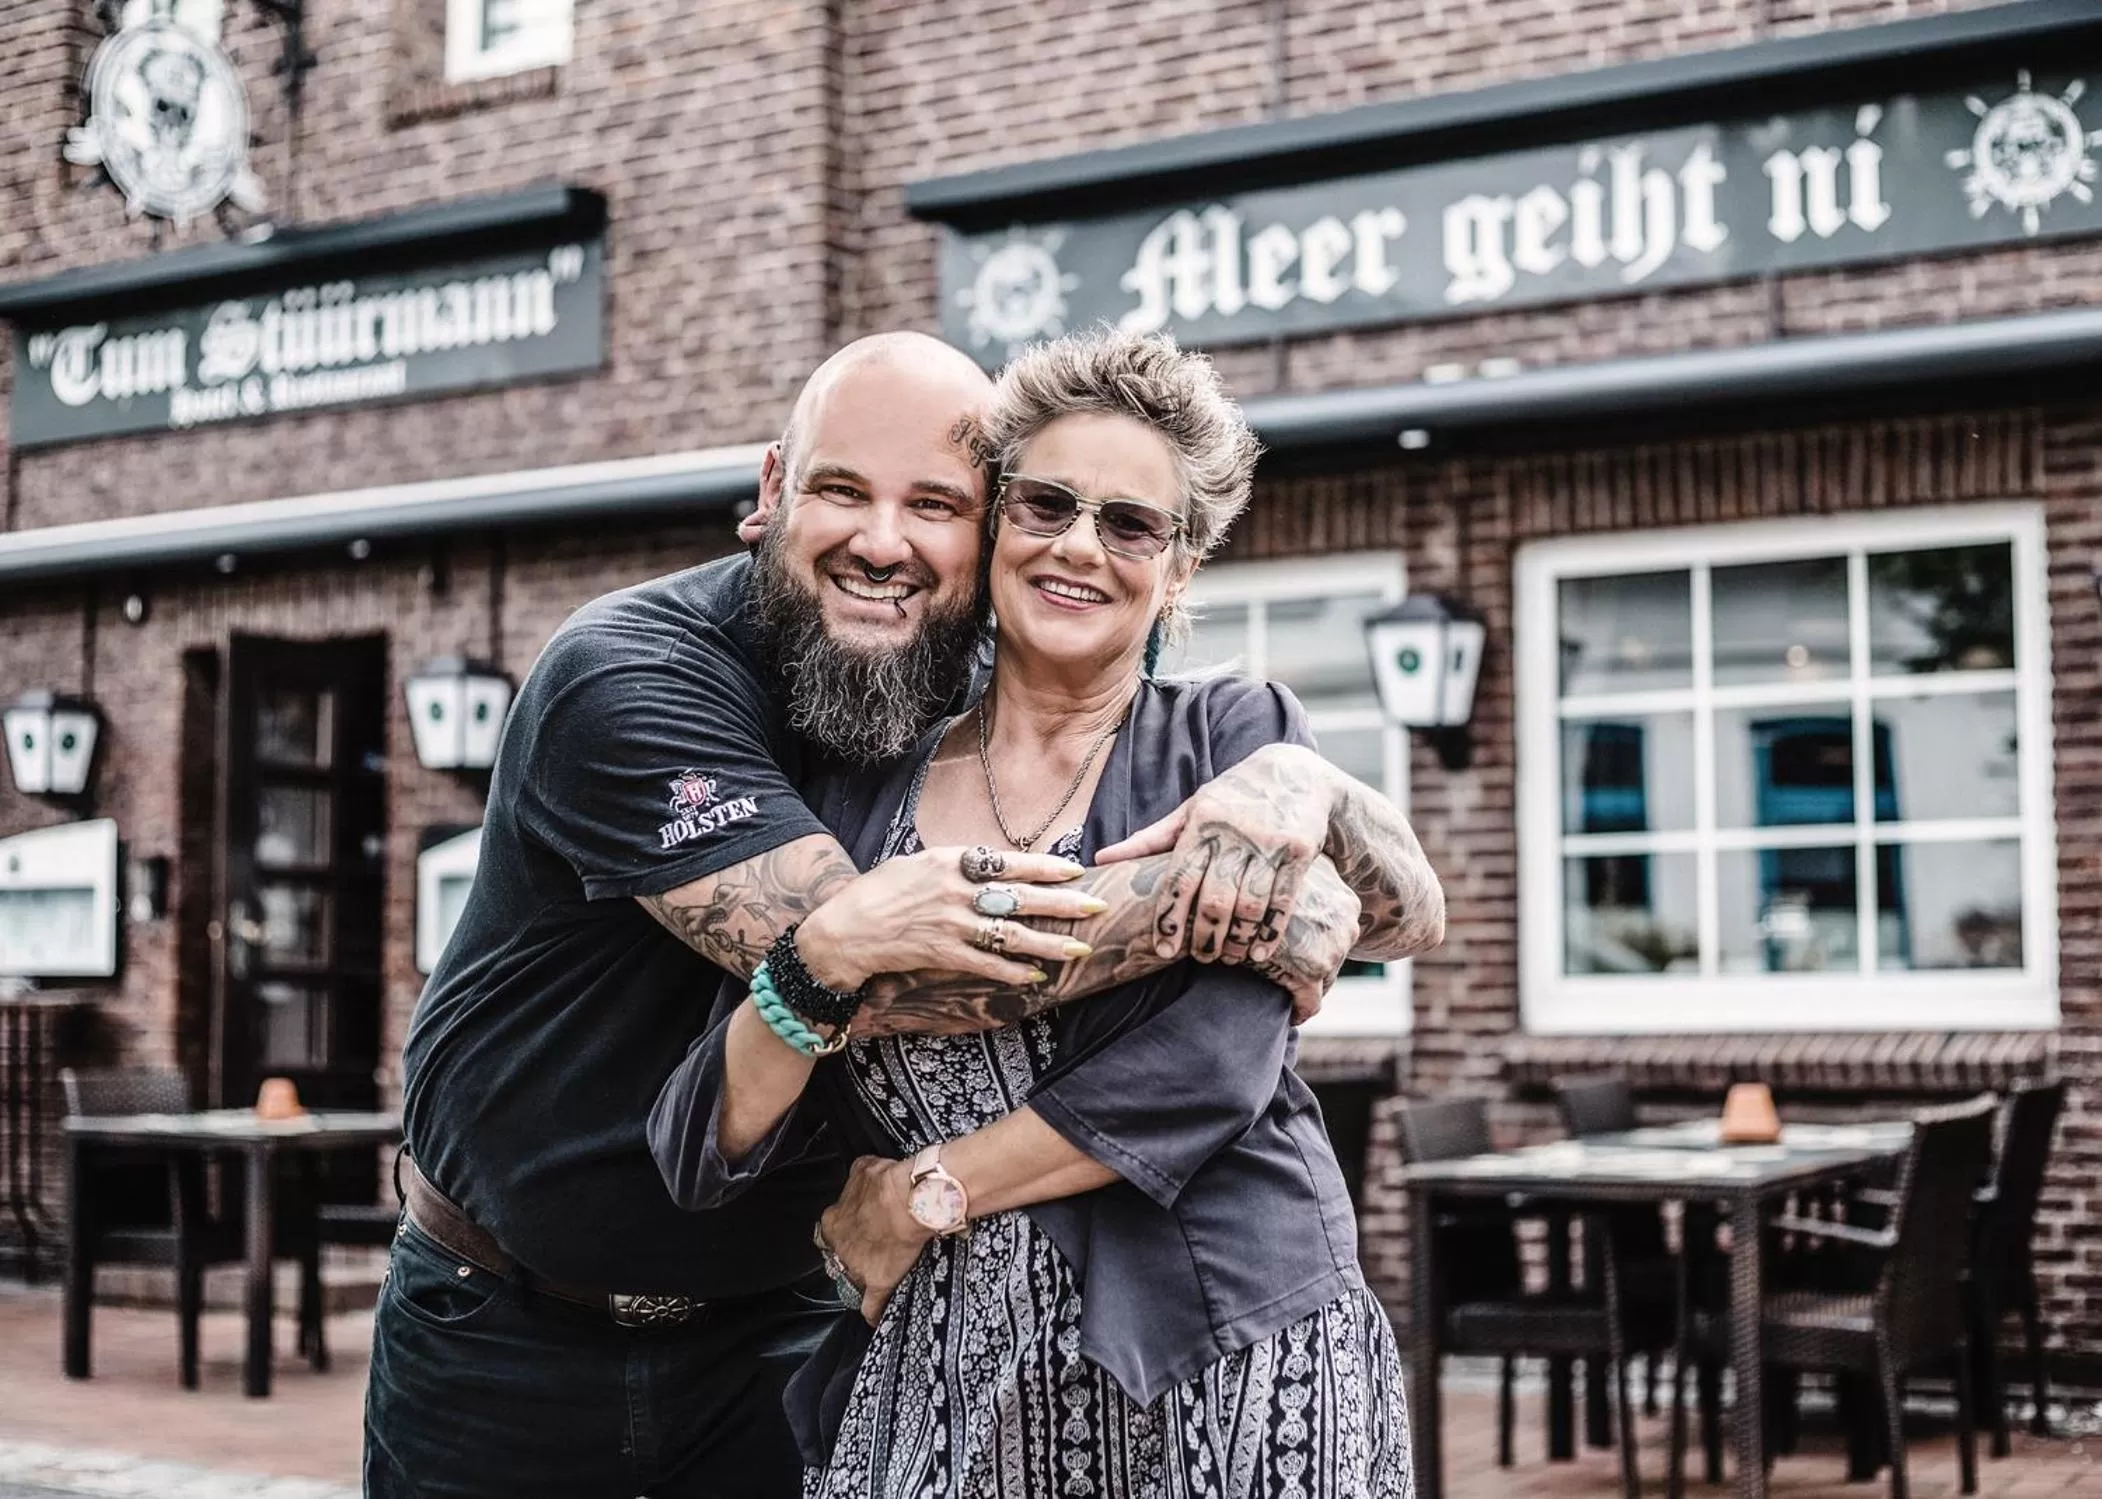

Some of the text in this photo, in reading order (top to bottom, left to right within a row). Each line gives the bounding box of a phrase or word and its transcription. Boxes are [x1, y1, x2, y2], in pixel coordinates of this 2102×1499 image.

[1118, 205, 1406, 332] Meer
[1442, 142, 1728, 304] geiht
[658, 796, 759, 848] HOLSTEN
